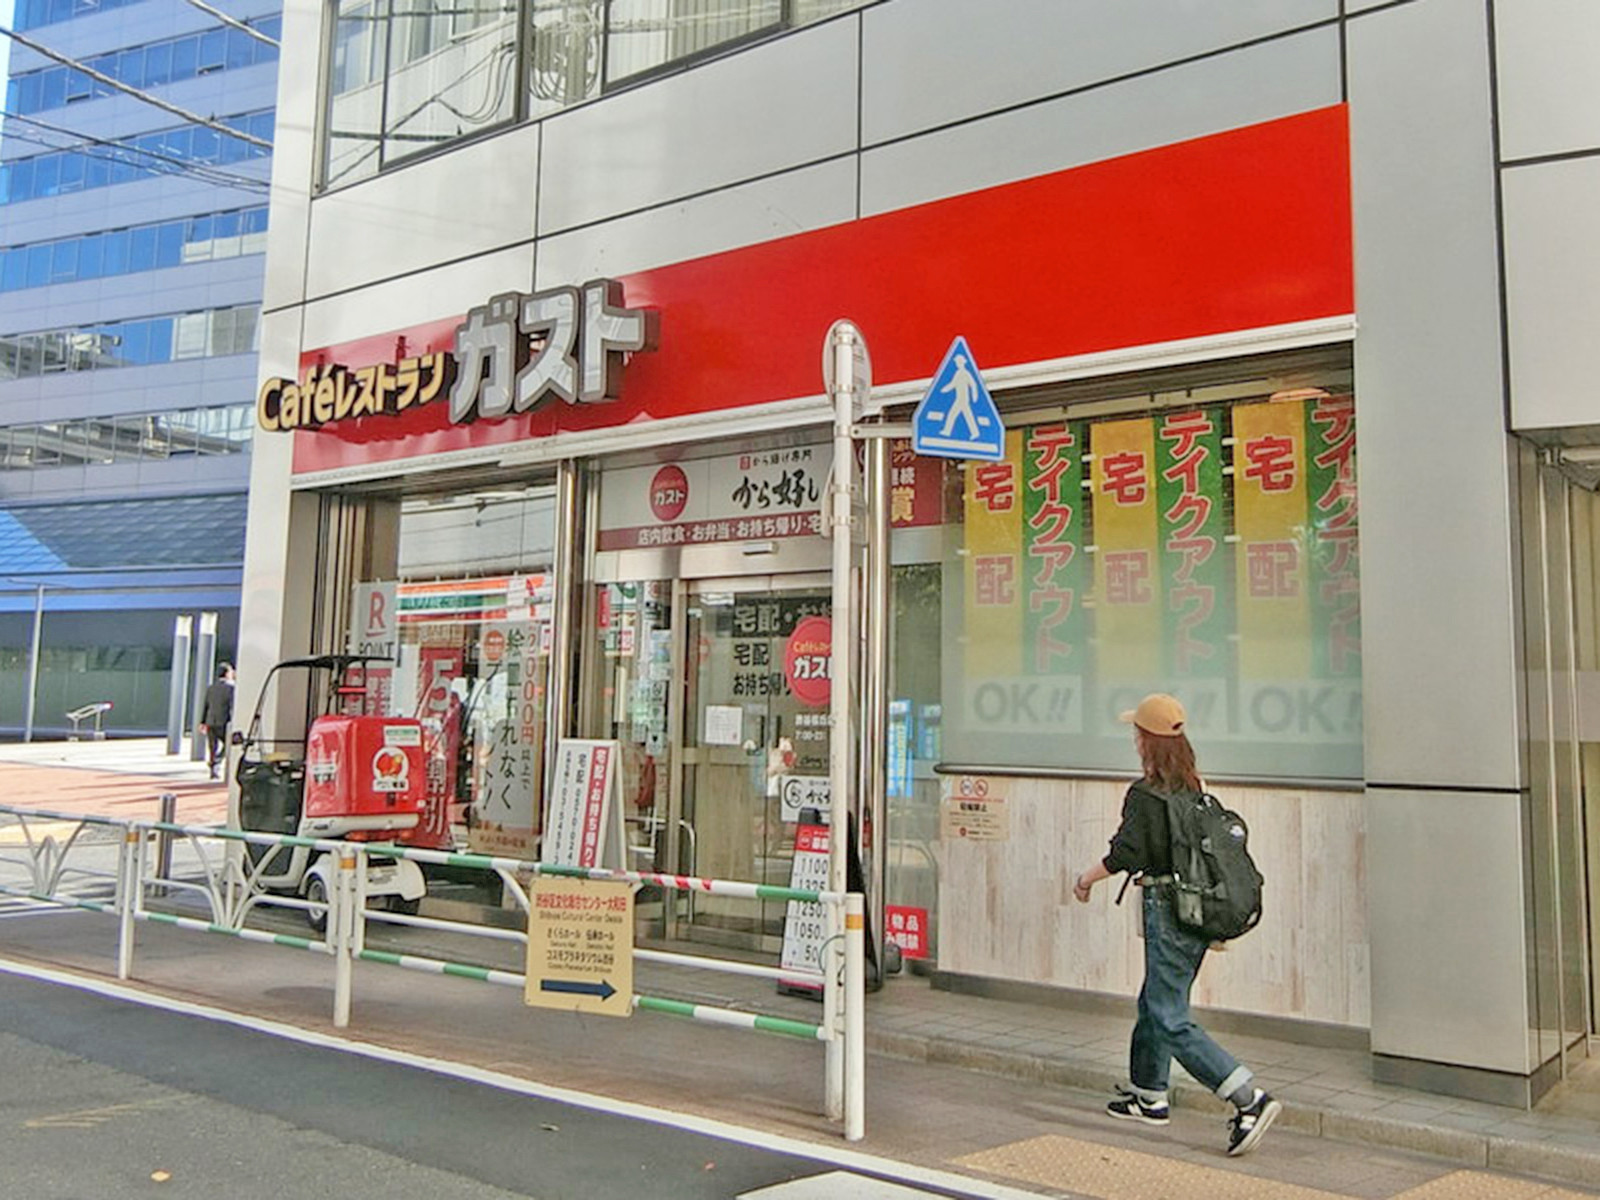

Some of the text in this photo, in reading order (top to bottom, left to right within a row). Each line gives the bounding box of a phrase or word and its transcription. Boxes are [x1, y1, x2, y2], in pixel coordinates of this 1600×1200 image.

[258, 350, 445, 432] Caféレストラン
[449, 278, 648, 424] ガスト
[654, 488, 685, 506] ガスト
[732, 468, 819, 509] から好し
[974, 462, 1015, 607] 宅配
[1028, 424, 1075, 674] テイクアウト
[1101, 452, 1152, 605] 宅配
[1159, 411, 1219, 674] テイクアウト
[1244, 435, 1299, 598] 宅配
[734, 642, 770, 666] 宅配
